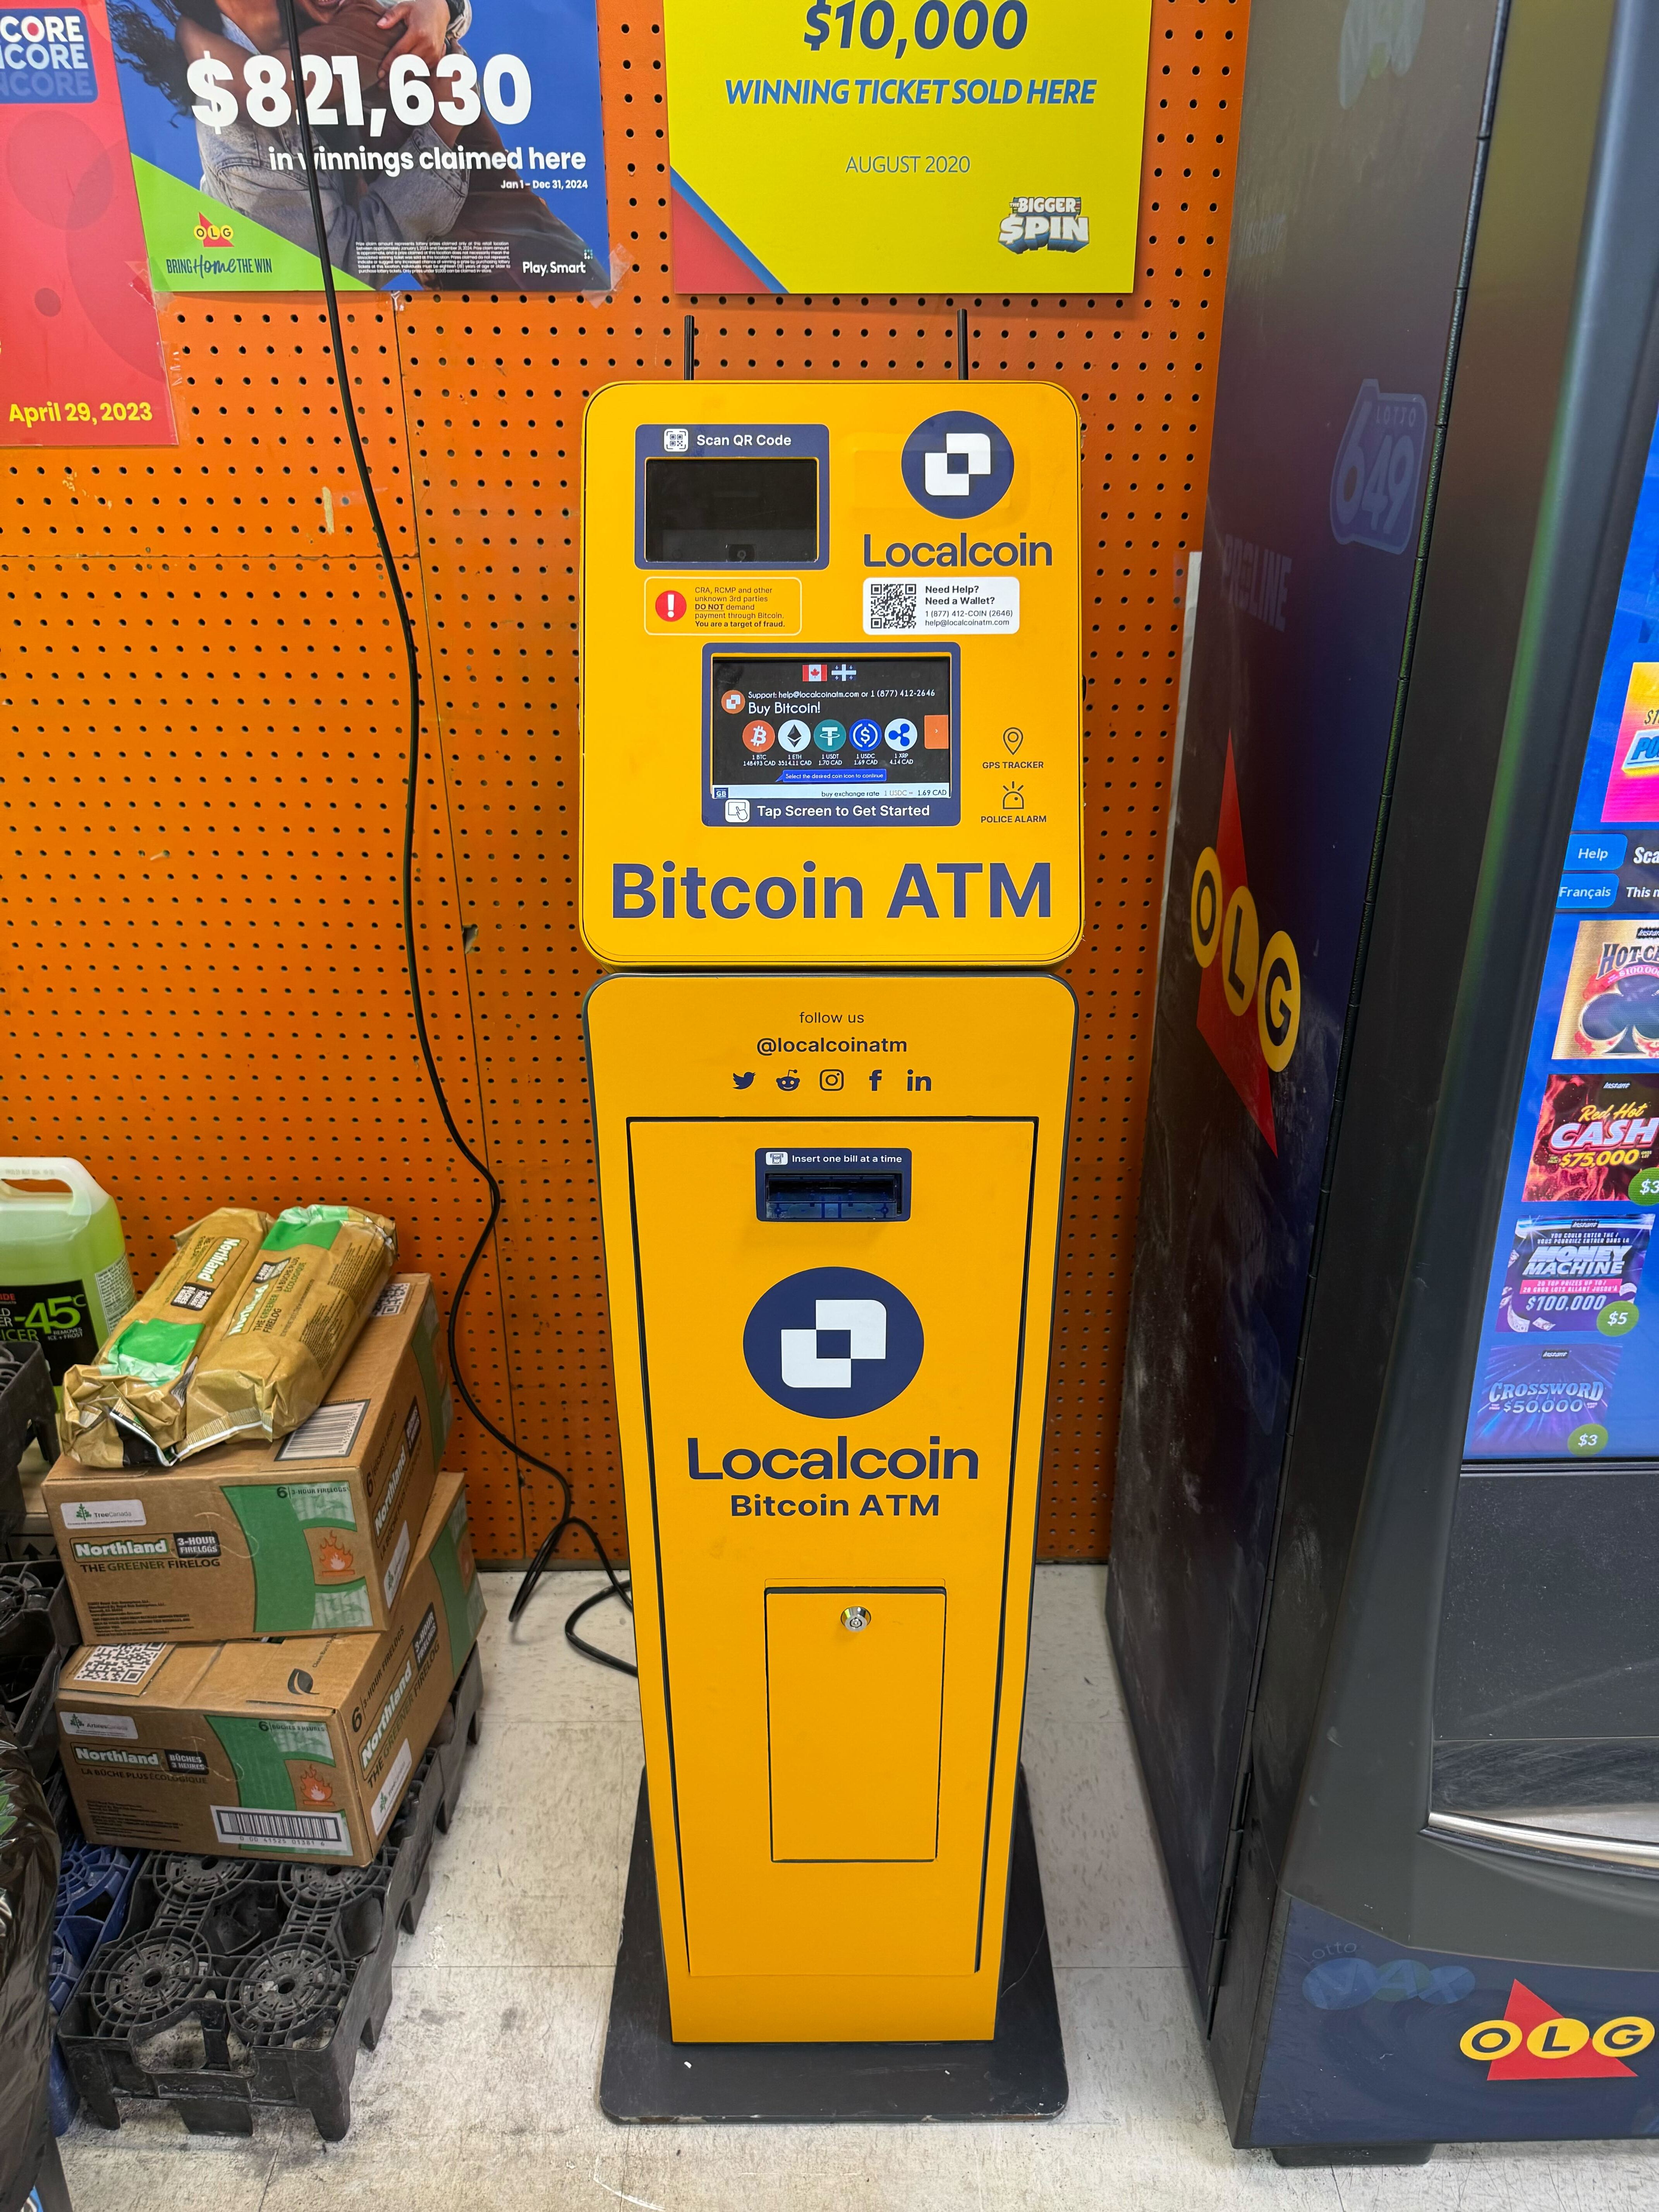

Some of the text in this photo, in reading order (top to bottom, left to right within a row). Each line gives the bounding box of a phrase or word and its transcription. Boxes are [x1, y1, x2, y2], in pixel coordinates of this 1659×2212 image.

[804, 0, 1027, 59] $10,000
[187, 51, 532, 137] $821,630
[726, 79, 1097, 104] WINNING TICKET SOLD HERE
[268, 146, 293, 170] in
[419, 146, 523, 170] claimed
[528, 146, 587, 170] here
[846, 156, 970, 173] AUGUST 2020
[501, 180, 519, 189] Jan
[532, 180, 550, 189] Dec
[552, 180, 563, 190] 31,
[565, 180, 588, 189] 2024
[1018, 197, 1076, 213] BIGGER
[196, 228, 231, 237] OLG
[166, 254, 272, 279] BRING Home THE WIN
[550, 261, 586, 273] Smart
[9, 401, 152, 428] April 29, 2023
[697, 435, 791, 446] Scan QR Code
[864, 532, 1052, 567] Localcoin
[952, 585, 979, 595] Help?
[748, 701, 820, 716] Buy Bitcoin!
[757, 805, 929, 818] Tap Screen to Get Started
[1578, 848, 1608, 860] Help
[613, 861, 1050, 919] Bitcoin ATM
[1559, 887, 1611, 899] Français
[1627, 887, 1650, 897] This
[1196, 869, 1292, 1046] OLG
[799, 1012, 864, 1023] follow us
[757, 1037, 907, 1056] @localcoinatm
[1578, 1102, 1647, 1122] Red Hot
[1551, 1118, 1659, 1148] CASH
[1559, 1149, 1639, 1168] $75,000
[198, 1238, 240, 1282] Northland
[1528, 1245, 1632, 1262] MONEY
[1522, 1261, 1625, 1275] MACHINE
[1526, 1295, 1606, 1311] $100,000
[1608, 1311, 1628, 1325] $5
[1489, 1381, 1603, 1402] CROSSWORD
[1578, 1434, 1597, 1447] $3
[688, 1436, 978, 1479] Localcoin
[732, 1494, 939, 1516] Bitcoin ATM
[75, 1540, 167, 1556] Northland
[177, 1536, 215, 1545] 3-HOUR
[180, 1546, 218, 1554] FIRELOGS
[81, 1558, 220, 1572] THE GREENER FIRELOG
[361, 1660, 412, 1769] Northland
[75, 1747, 160, 1765] Northland
[1471, 2024, 1642, 2052] OLG
